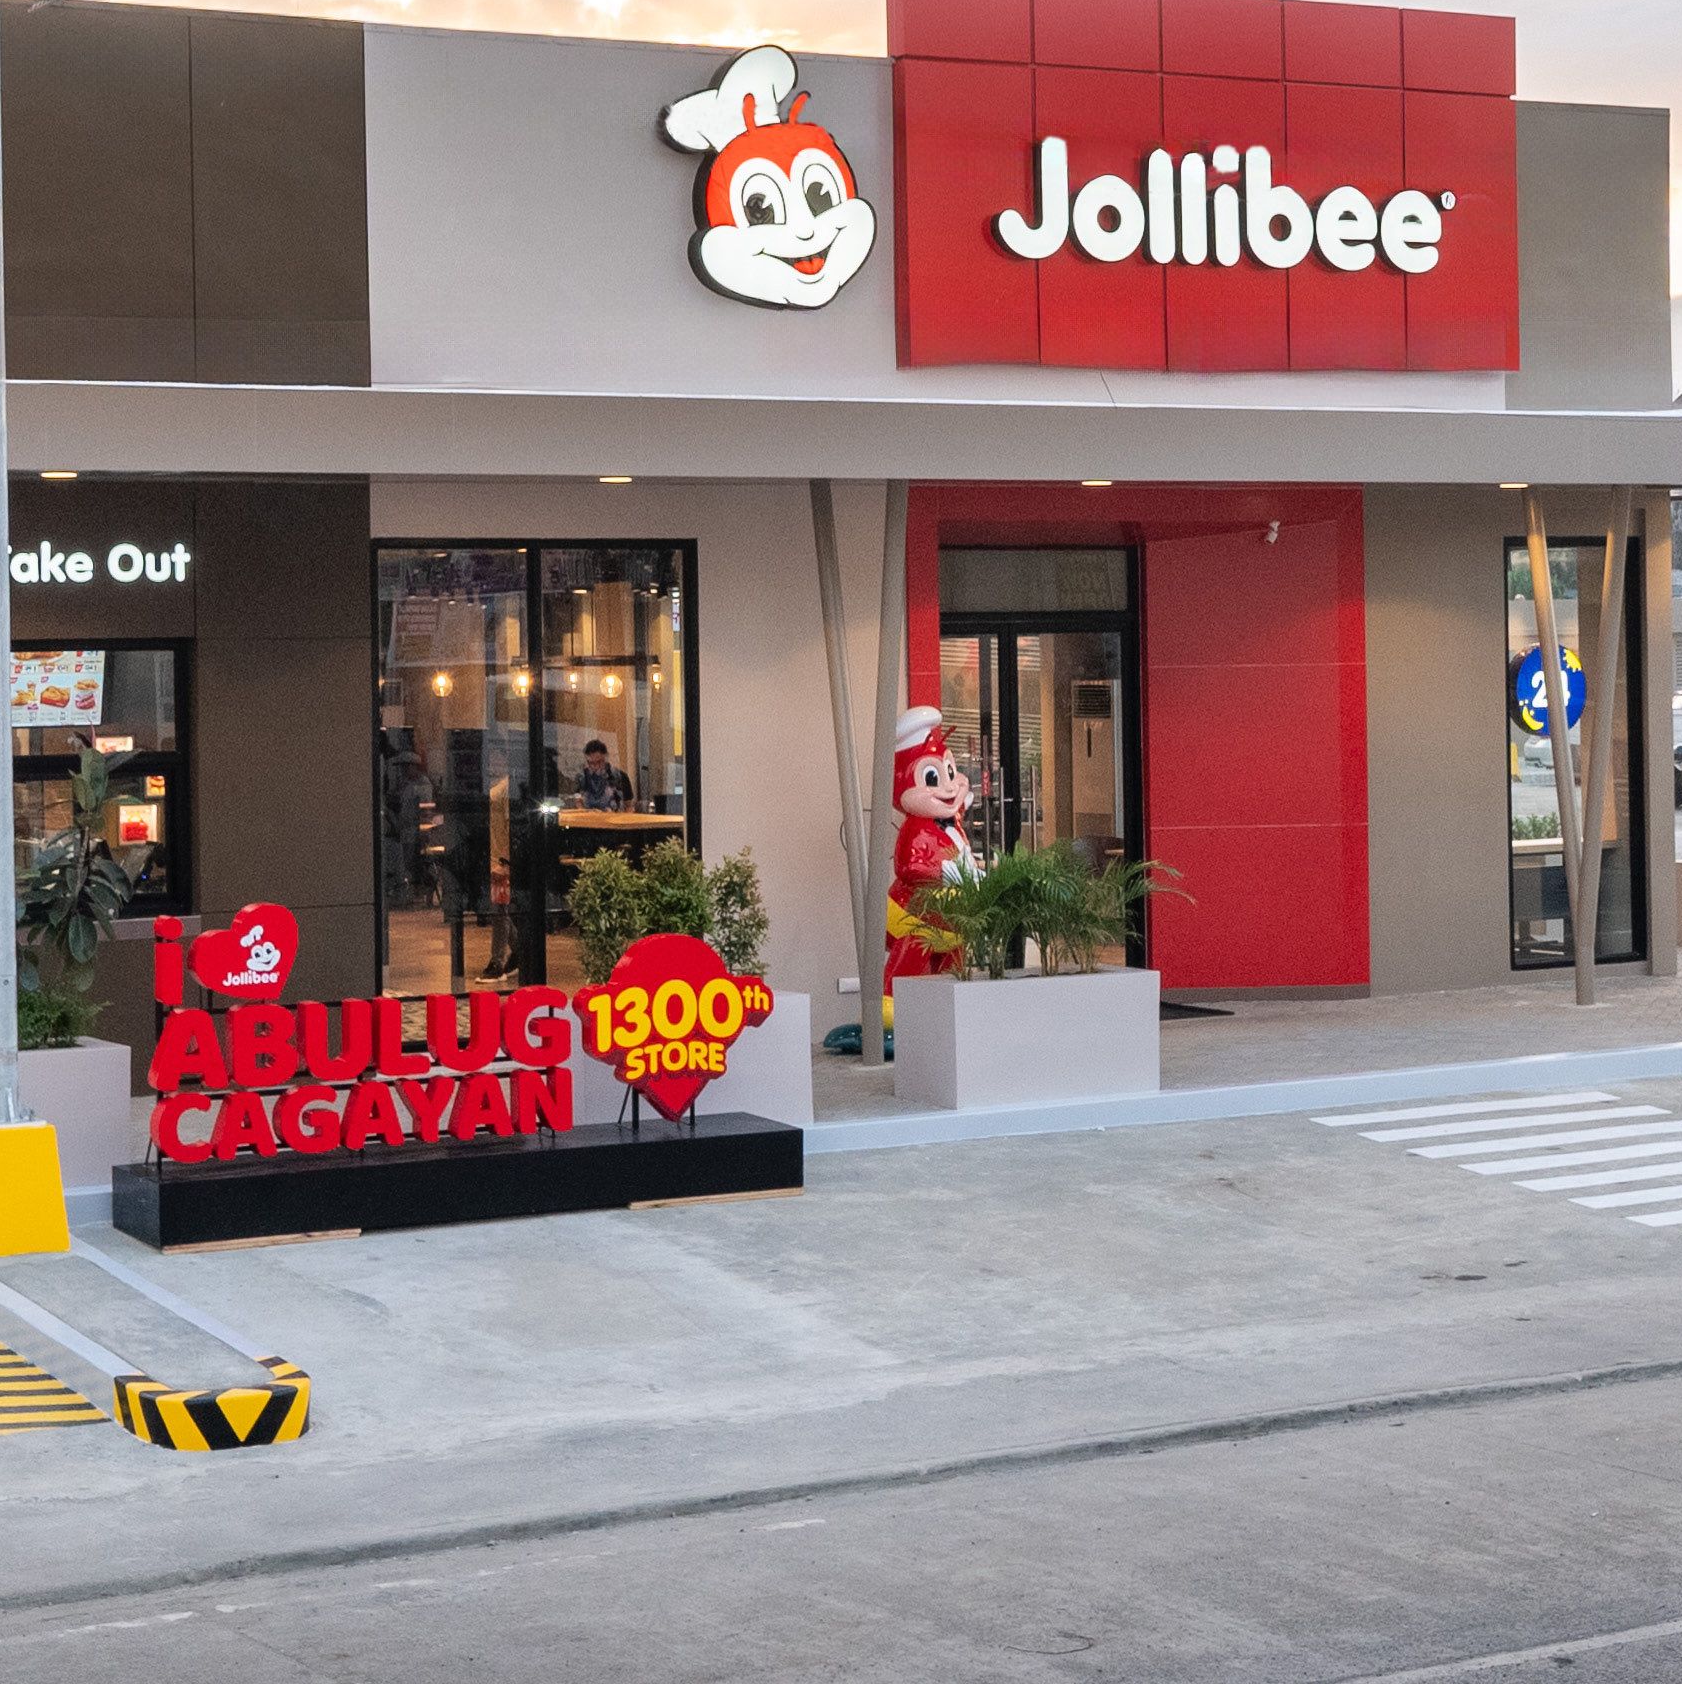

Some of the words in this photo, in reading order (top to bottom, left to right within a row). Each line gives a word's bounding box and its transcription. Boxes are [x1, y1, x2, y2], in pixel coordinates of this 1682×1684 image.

[107, 542, 191, 582] Out
[222, 970, 278, 987] Jollibee
[148, 984, 572, 1093] ABULUG
[625, 1040, 726, 1080] STORE
[150, 1066, 574, 1164] CAGAYAN
